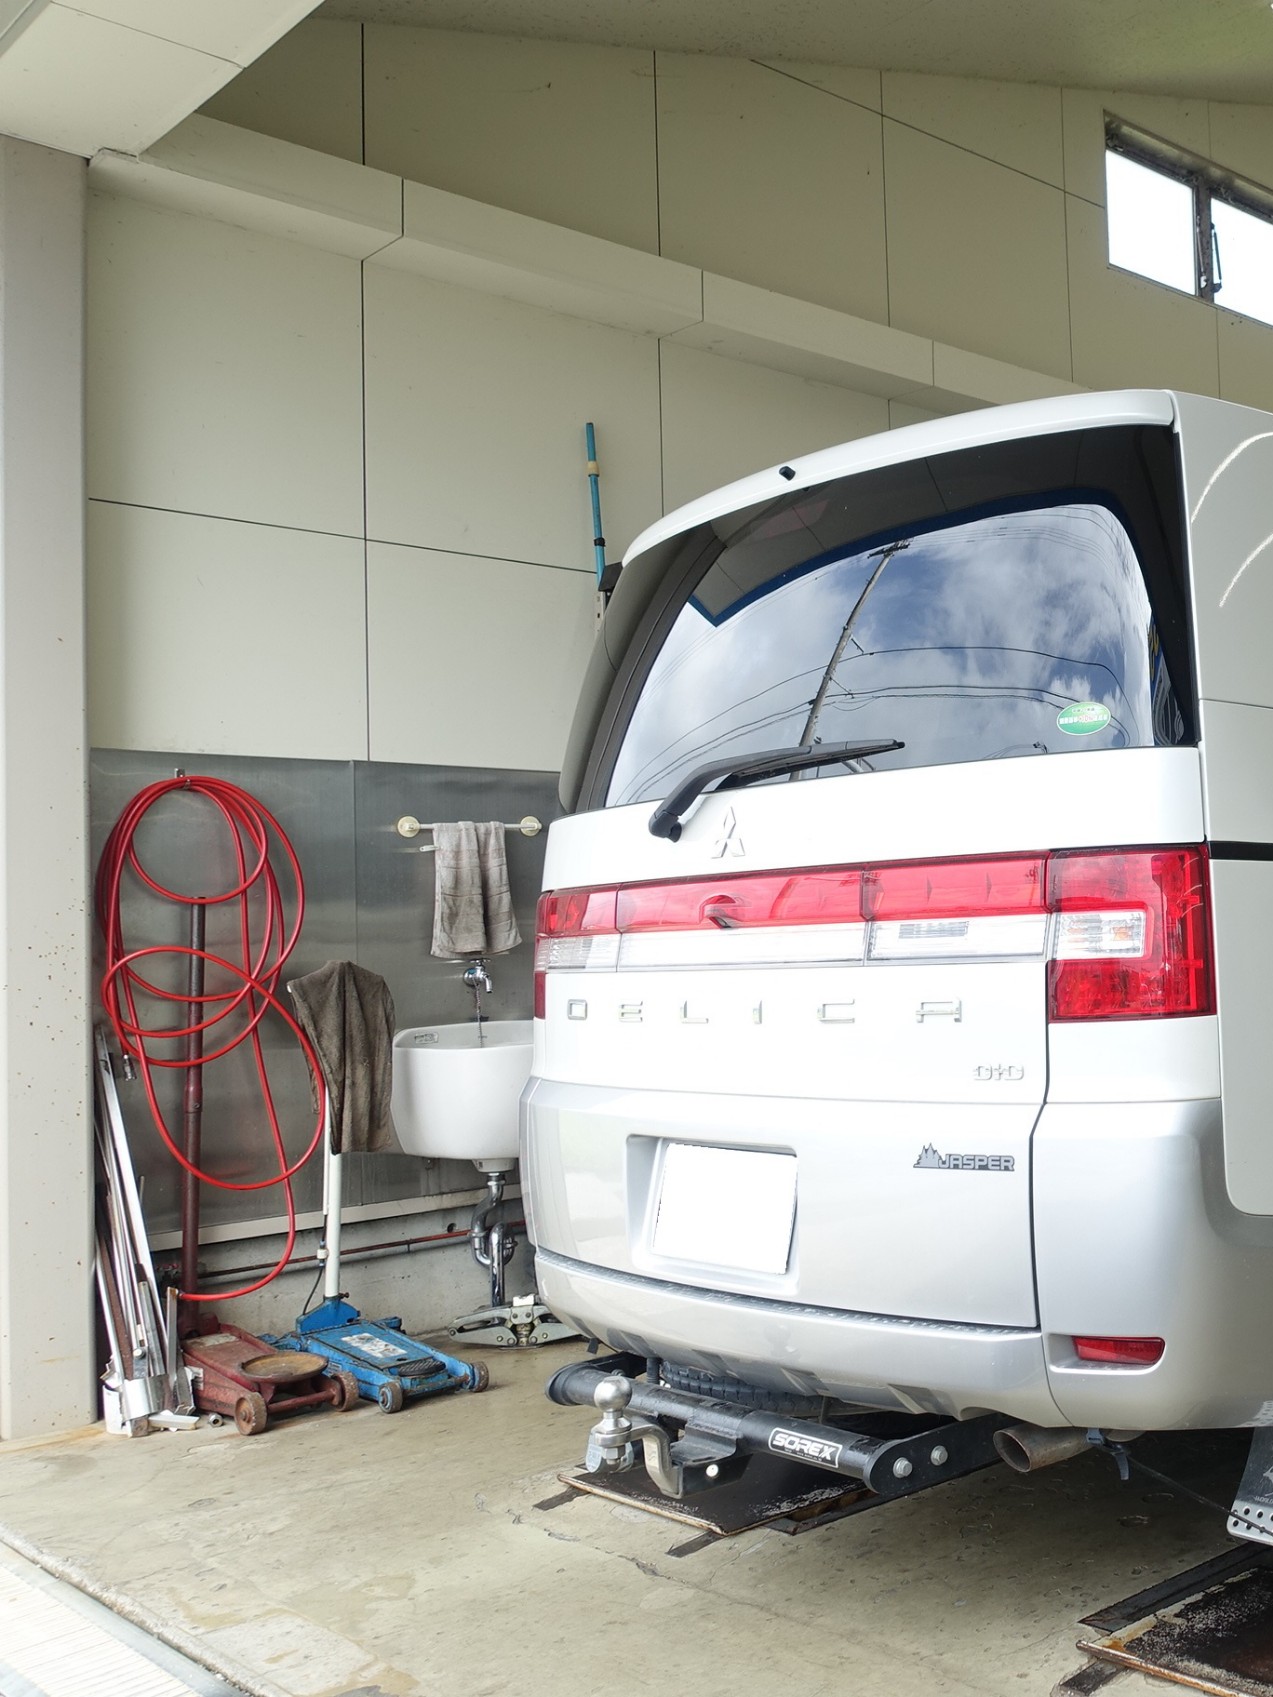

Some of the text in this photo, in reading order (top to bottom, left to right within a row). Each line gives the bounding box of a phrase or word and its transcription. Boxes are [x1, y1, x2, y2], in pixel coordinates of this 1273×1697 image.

[567, 998, 962, 1025] DELICA
[938, 1153, 1015, 1172] JASPER
[772, 1433, 837, 1461] SOREX
